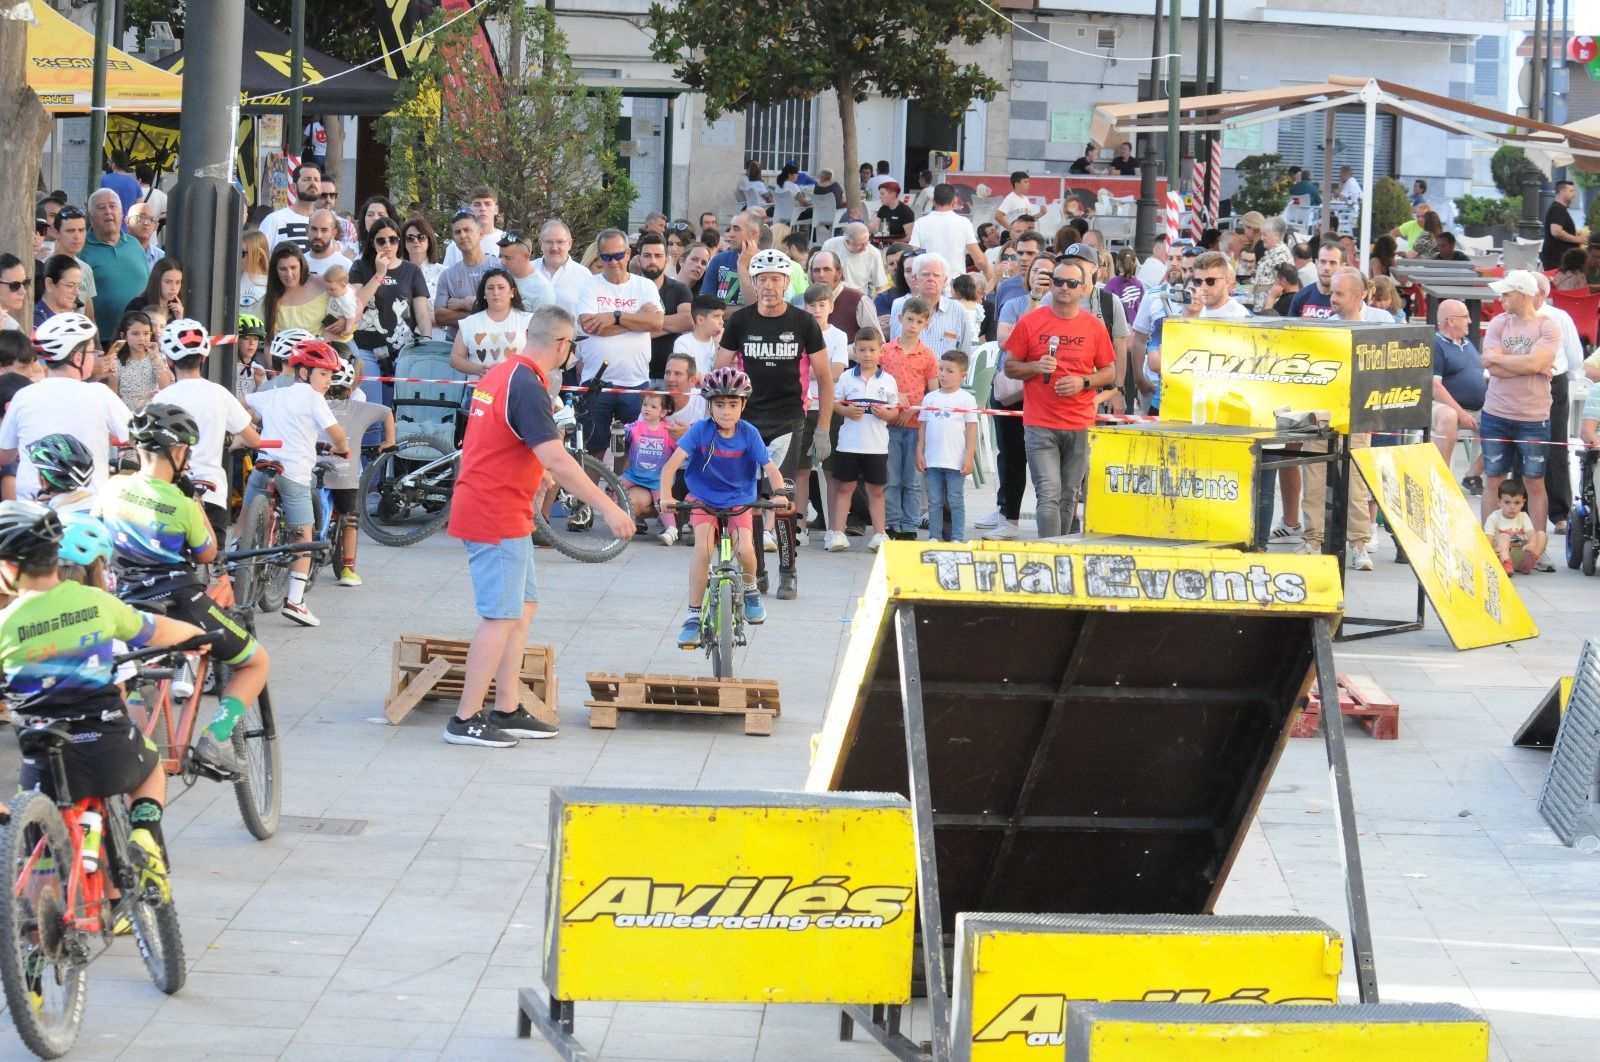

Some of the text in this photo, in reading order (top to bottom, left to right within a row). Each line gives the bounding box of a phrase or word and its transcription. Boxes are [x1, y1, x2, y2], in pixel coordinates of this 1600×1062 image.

[1356, 341, 1431, 371] Trial Events
[1503, 336, 1533, 348] DETROI
[1105, 465, 1158, 495] Trial
[920, 550, 1308, 604] Trial Events
[562, 876, 913, 926] Avilés
[614, 912, 883, 931] avilesracing.com
